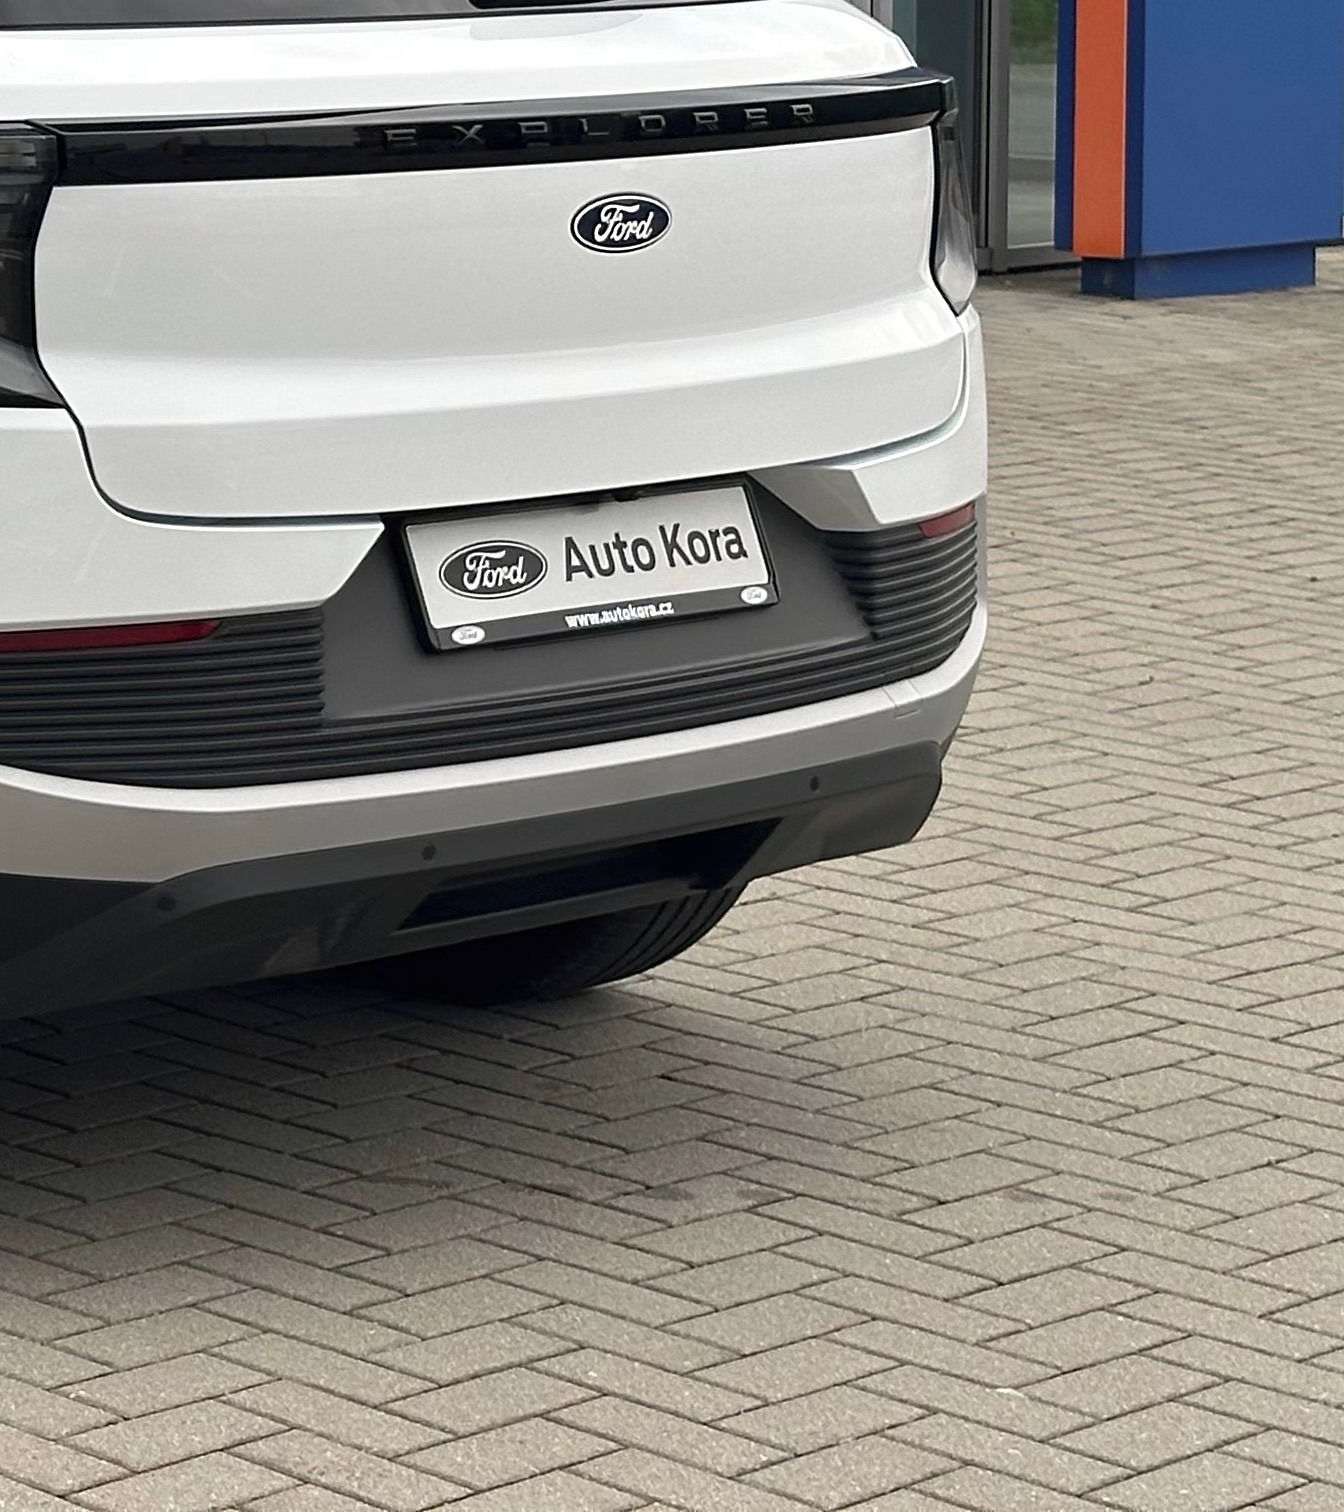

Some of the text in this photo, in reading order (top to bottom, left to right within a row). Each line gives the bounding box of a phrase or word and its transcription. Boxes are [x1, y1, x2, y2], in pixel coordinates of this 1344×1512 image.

[384, 104, 813, 148] EXPLORER
[594, 204, 654, 243] Ford
[462, 522, 749, 591] Ford Auto Kora
[565, 600, 674, 629] www.autokora.cz
